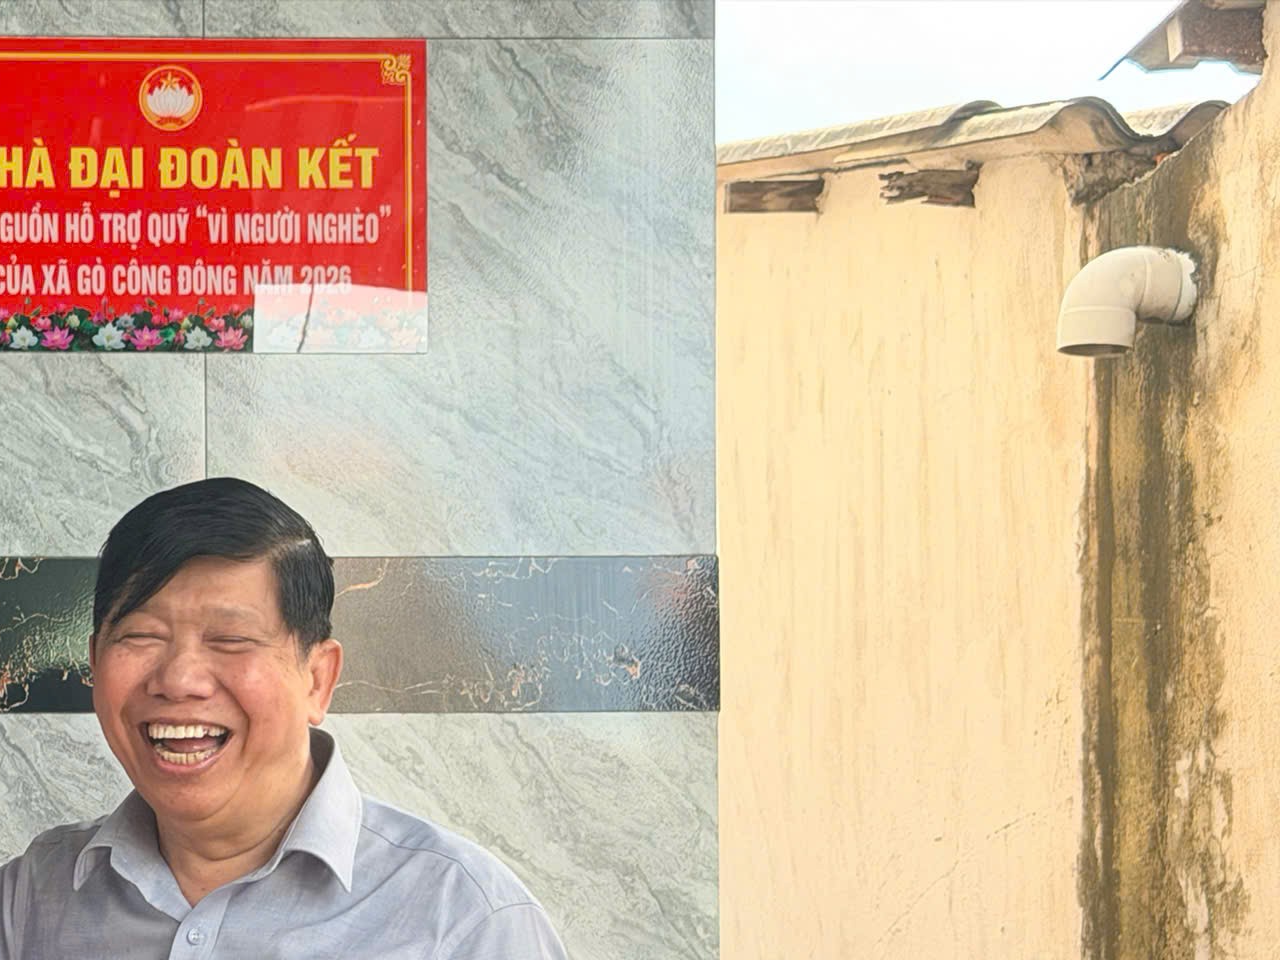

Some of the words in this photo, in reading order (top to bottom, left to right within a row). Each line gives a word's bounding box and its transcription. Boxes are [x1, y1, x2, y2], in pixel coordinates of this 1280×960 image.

[68, 146, 145, 199] ĐẠI
[158, 138, 283, 189] ĐOÀN
[297, 133, 380, 189] KẾT
[65, 201, 95, 243] HỖ
[100, 209, 142, 250] TRỢ
[147, 207, 190, 247] QUỸ
[234, 205, 301, 244] NGƯỜI
[41, 258, 71, 295] XÃ
[77, 257, 107, 295] GÒ
[112, 258, 172, 295] CÔNG
[177, 258, 239, 295] ĐÔNG
[243, 258, 294, 295] NĂM
[300, 265, 353, 295] 2026
